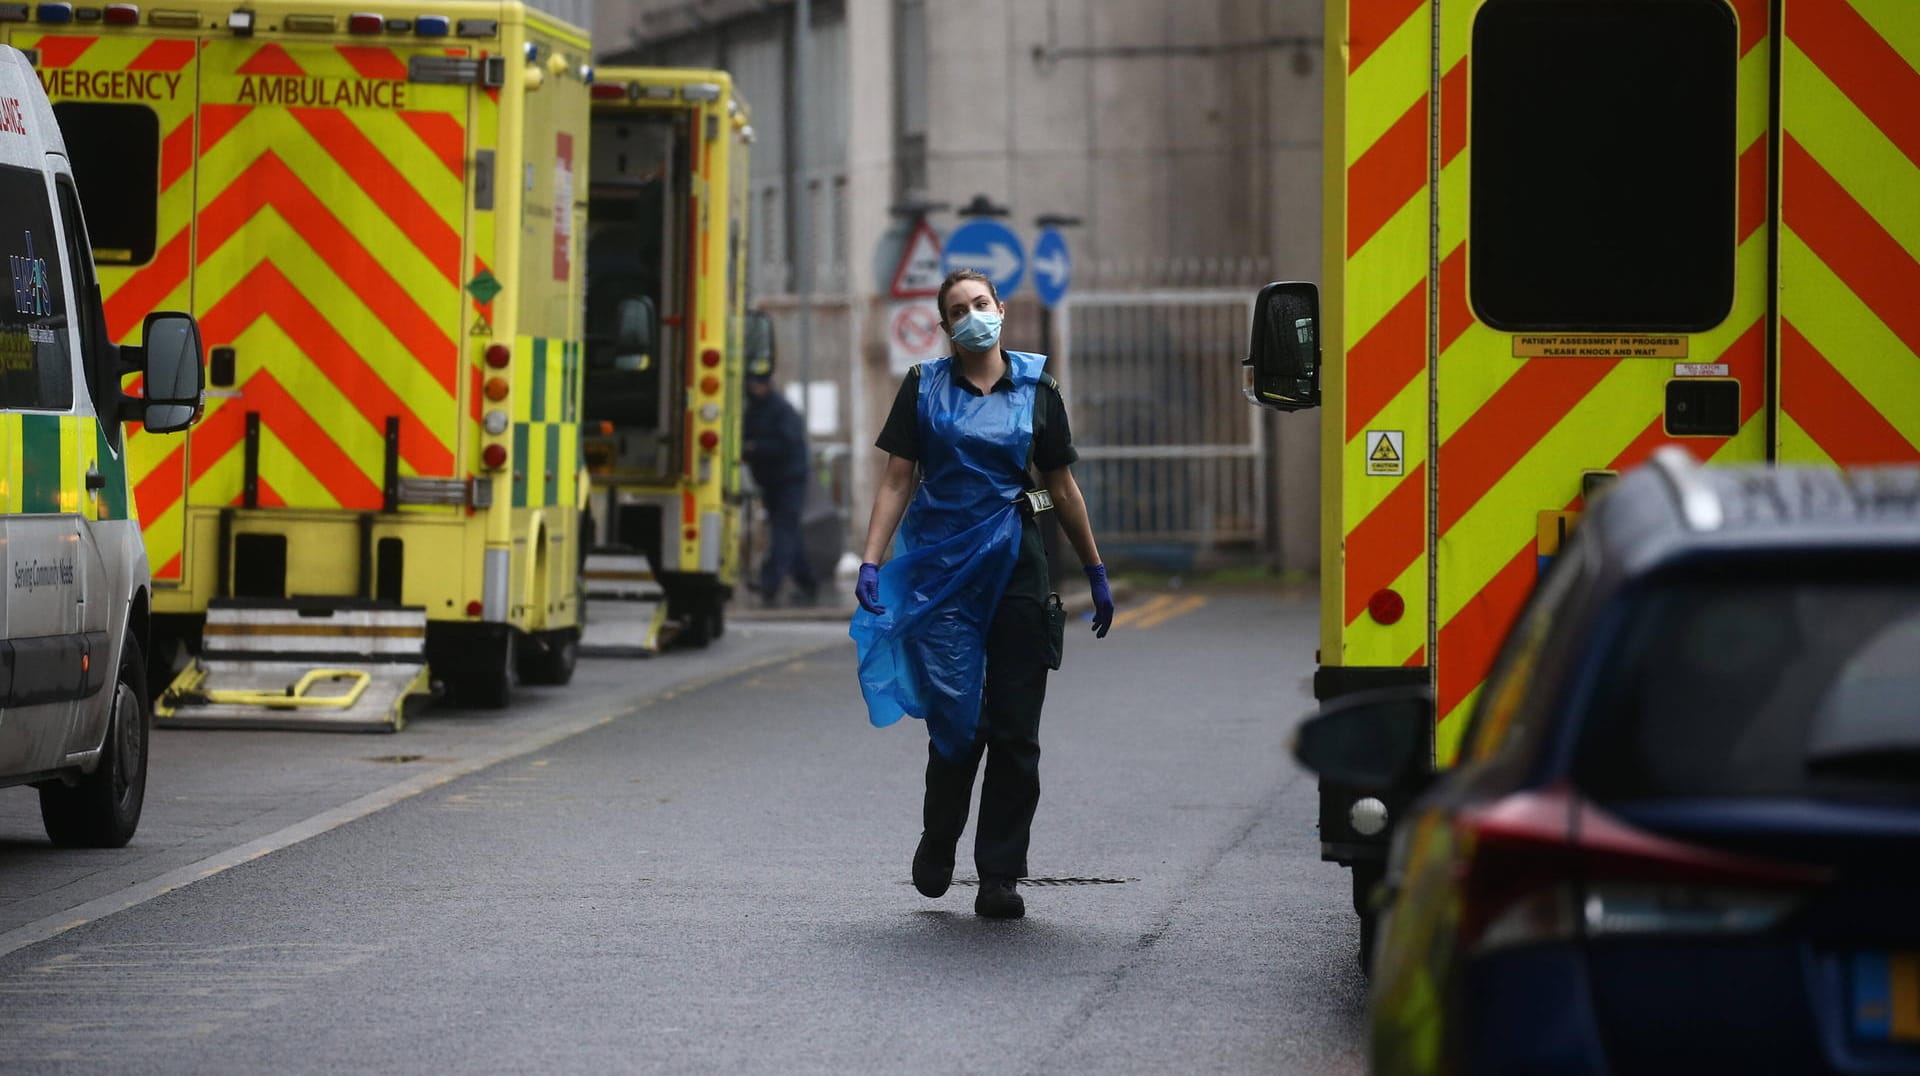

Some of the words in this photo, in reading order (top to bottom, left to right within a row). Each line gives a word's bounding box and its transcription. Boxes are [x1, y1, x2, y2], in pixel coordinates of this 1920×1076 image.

[36, 70, 182, 99] MERGENCY
[238, 76, 405, 108] AMBULANCE
[1543, 348, 1577, 356] PLEASE
[1579, 348, 1611, 356] KNOCK
[1613, 348, 1632, 356] AND
[1634, 348, 1657, 356] WAIT
[1632, 338, 1680, 346] PROGRESS
[15, 560, 32, 593] Serving
[33, 558, 59, 590] Community
[60, 556, 74, 585] Needs
